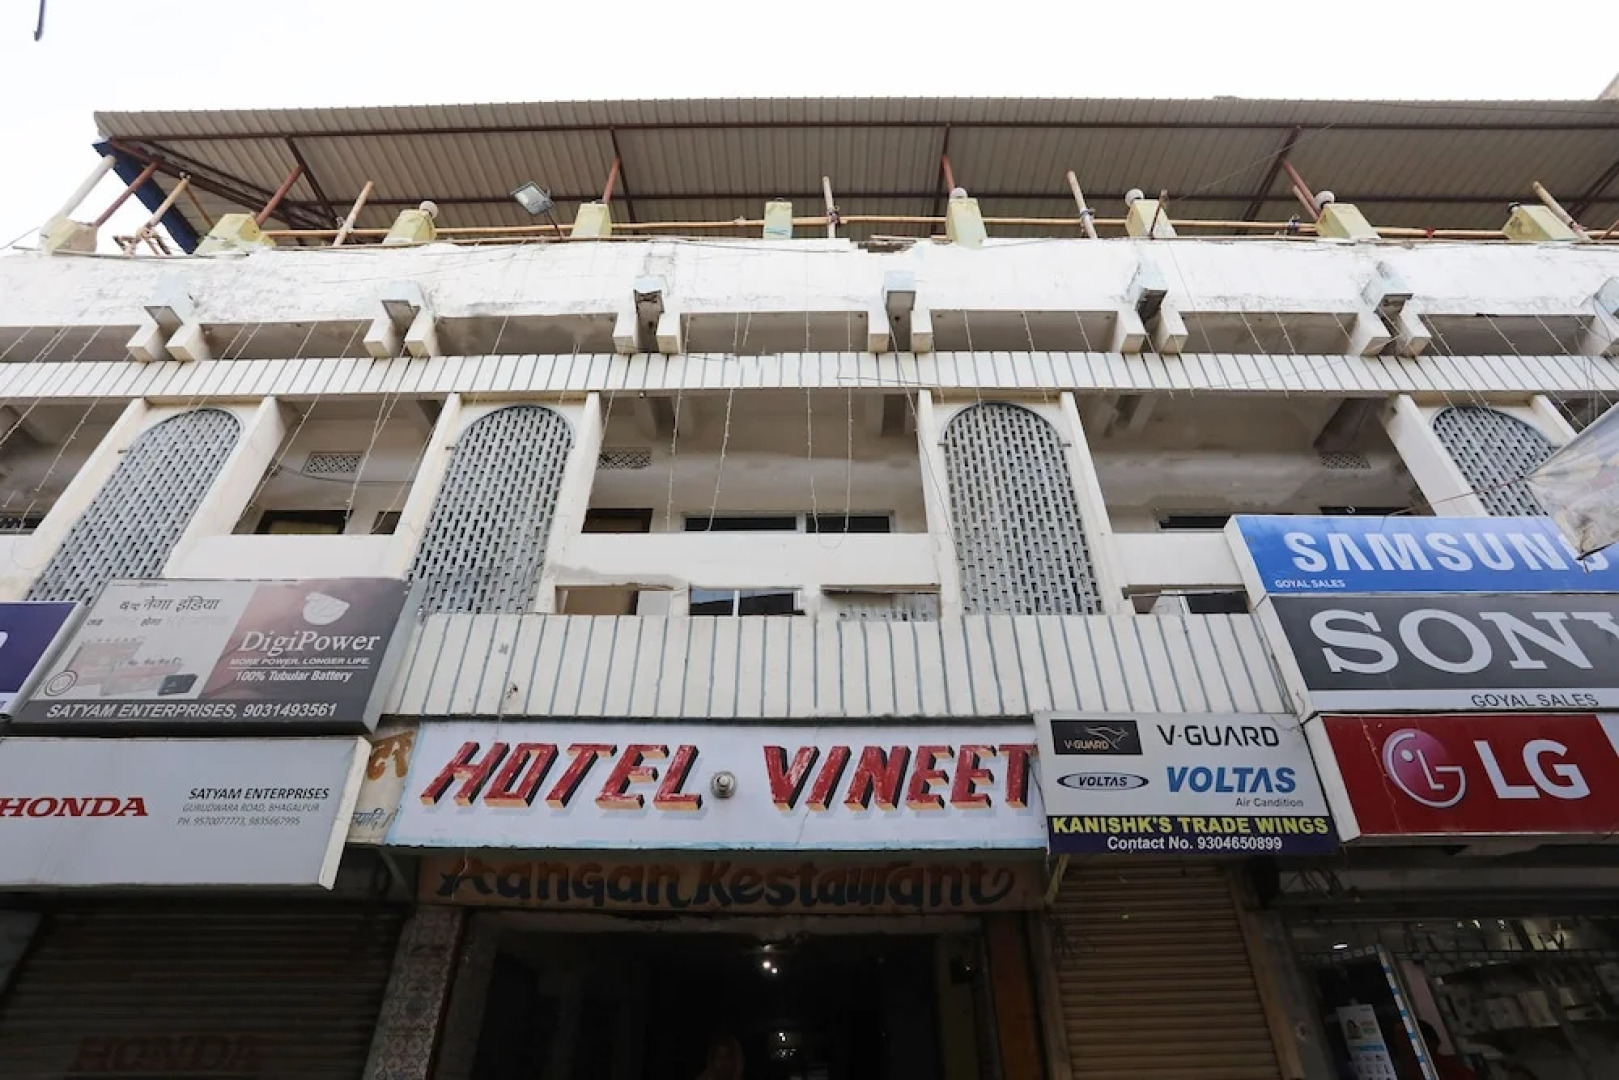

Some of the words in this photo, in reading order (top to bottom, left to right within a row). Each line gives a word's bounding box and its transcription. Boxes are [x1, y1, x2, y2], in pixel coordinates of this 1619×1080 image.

[1275, 579, 1309, 588] GOYAL
[1310, 579, 1345, 588] SALES
[237, 630, 381, 656] DigiPower
[236, 671, 265, 681] 100%
[268, 670, 311, 681] Tubular
[311, 670, 353, 683] Battery
[1471, 693, 1536, 708] GOYAL
[1540, 693, 1599, 708] SALES
[47, 703, 119, 718] SATYAM
[117, 703, 237, 720] ENTERPRISES,
[242, 702, 338, 718] 9031493561
[1157, 724, 1279, 747] V-GUARD
[419, 741, 704, 810] HOTEL
[763, 744, 1040, 812] VINEET
[1473, 739, 1591, 799] LG
[1079, 776, 1128, 787] VOLTAS
[1167, 766, 1296, 793] VOLTAS
[188, 788, 242, 799] SATYAM
[244, 788, 329, 799] ENTERPRISES
[0, 797, 149, 817] HONDA
[182, 803, 239, 812] GURUDWARA
[268, 803, 320, 812] BHAGALPUR
[1235, 798, 1251, 806] Air
[1053, 816, 1173, 834] KANISHK'S
[1178, 817, 1250, 834] TRADE
[1255, 817, 1329, 834] WINGS
[1107, 836, 1165, 850] Contact
[1168, 837, 1194, 850] No.
[1197, 836, 1283, 850] 9304650899
